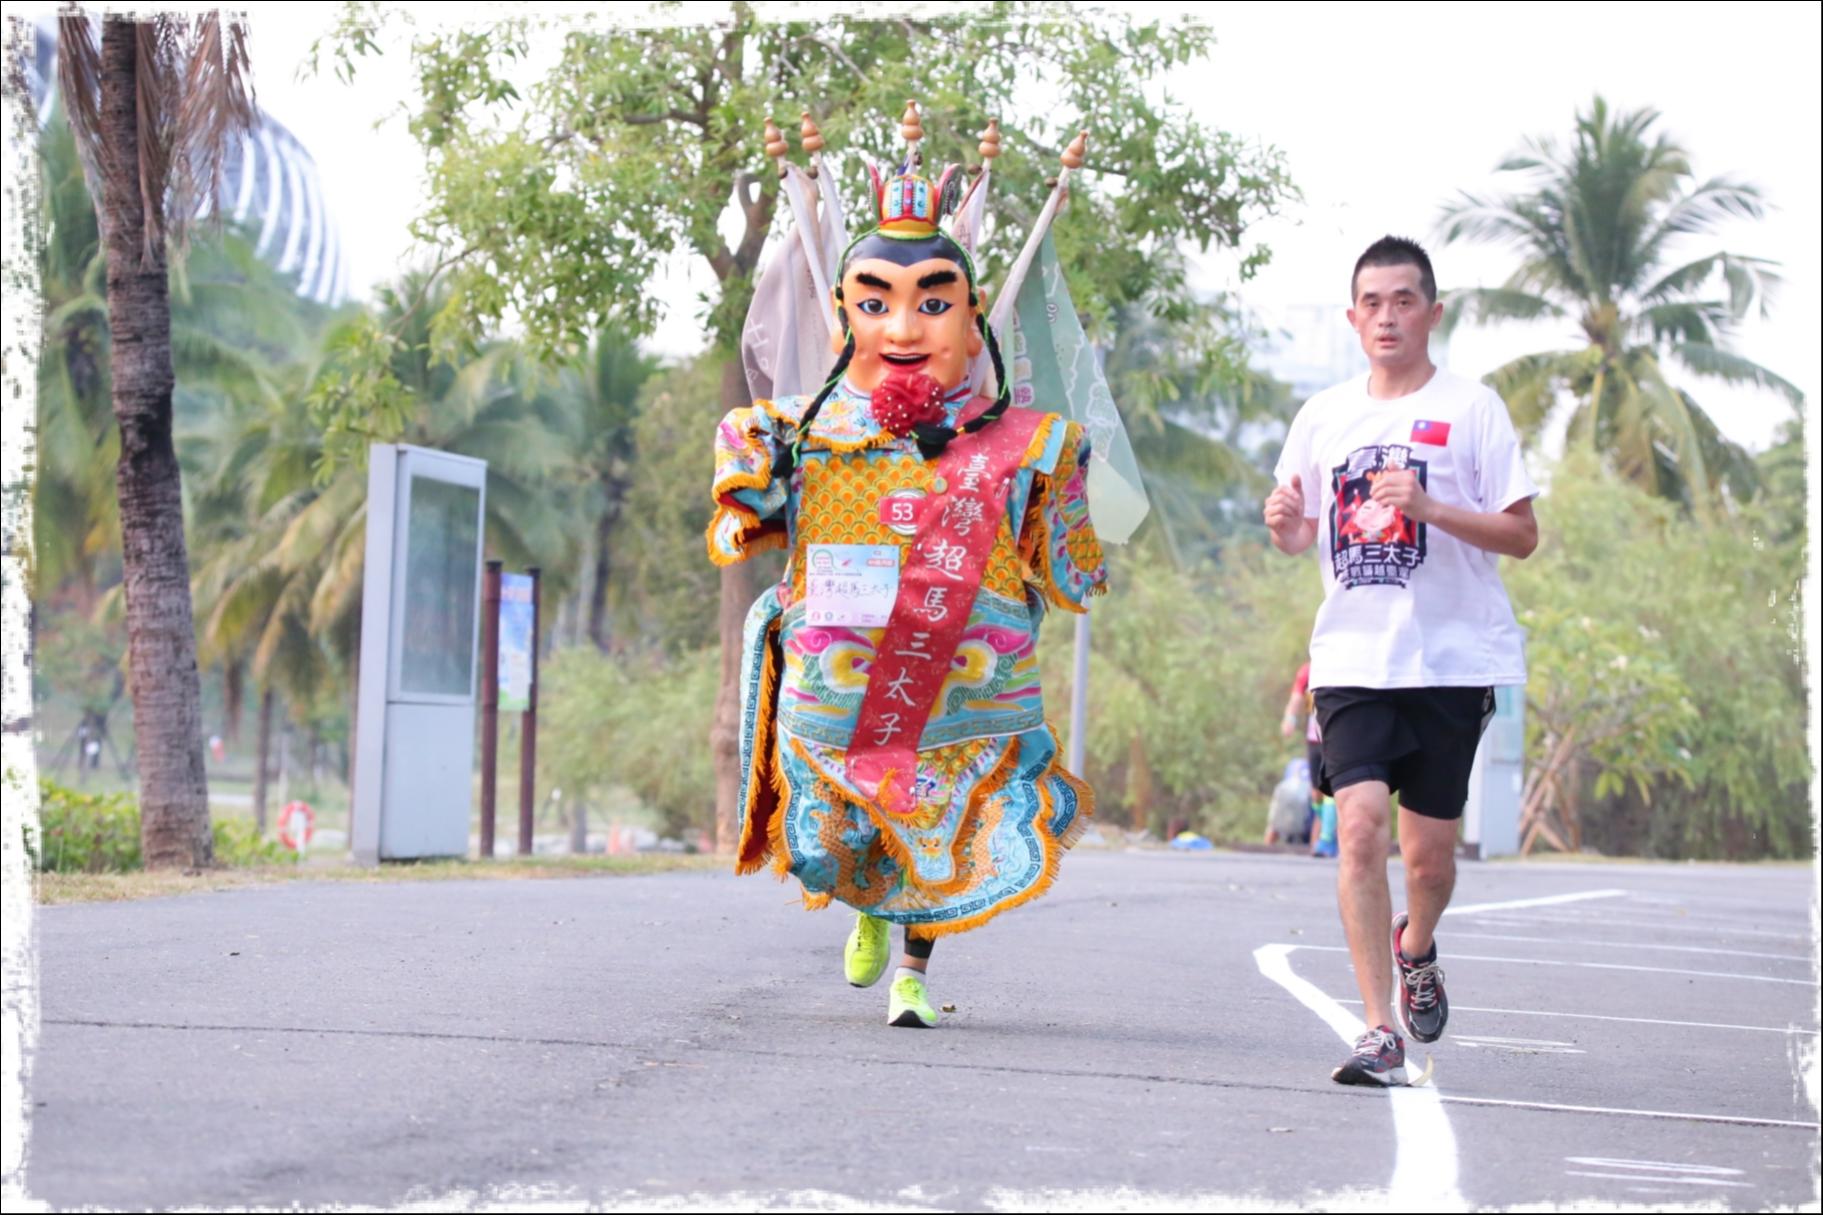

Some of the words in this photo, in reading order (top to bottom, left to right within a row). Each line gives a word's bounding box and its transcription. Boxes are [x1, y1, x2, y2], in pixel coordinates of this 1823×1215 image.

[892, 502, 914, 521] 53
[873, 453, 992, 746] 臺灣超馬三太子
